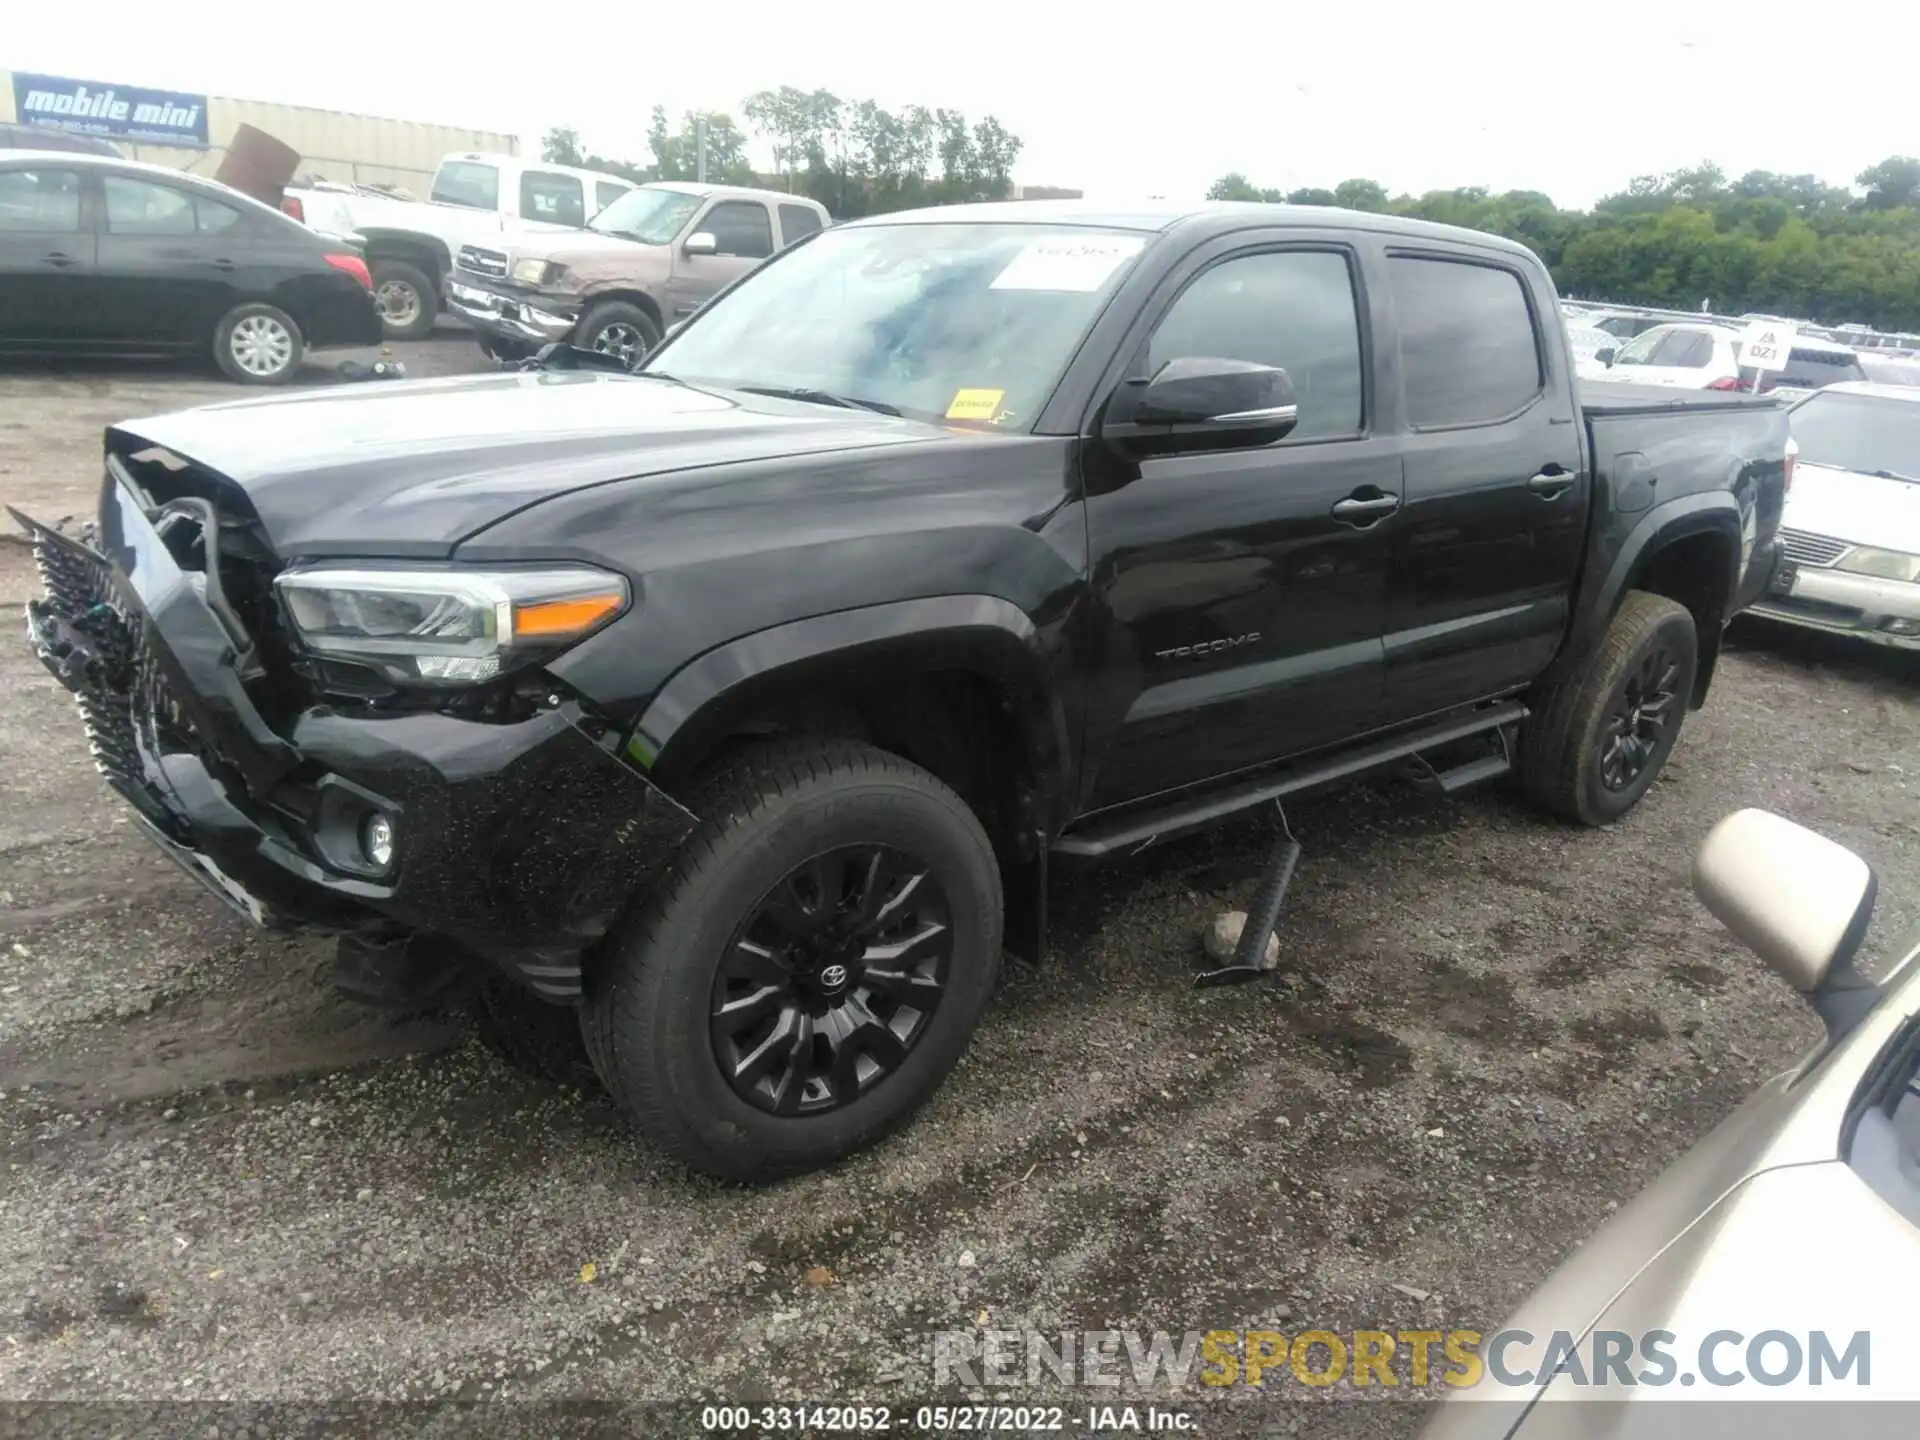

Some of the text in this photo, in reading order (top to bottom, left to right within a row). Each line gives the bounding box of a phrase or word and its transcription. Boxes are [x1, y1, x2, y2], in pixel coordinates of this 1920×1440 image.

[24, 86, 129, 120] mobile
[132, 101, 201, 128] mini
[1155, 632, 1261, 657] TACOMA
